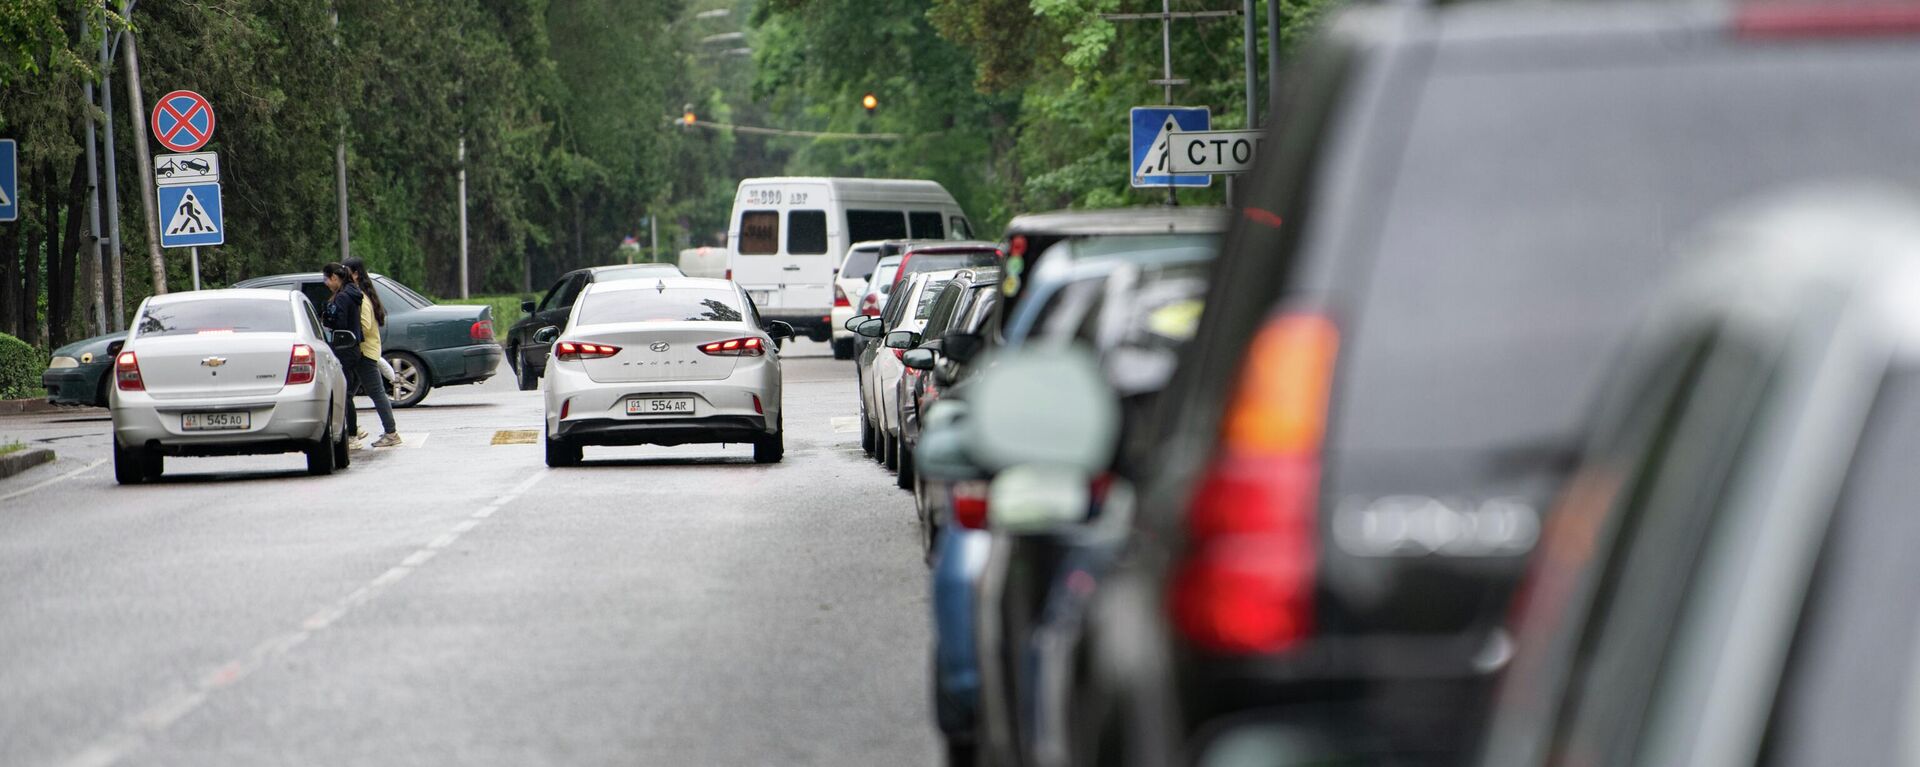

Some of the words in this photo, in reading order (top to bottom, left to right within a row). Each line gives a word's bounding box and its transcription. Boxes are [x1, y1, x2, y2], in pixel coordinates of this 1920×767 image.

[651, 400, 672, 411] 554
[675, 401, 686, 410] AR
[207, 414, 228, 425] 545
[230, 415, 242, 425] AO
